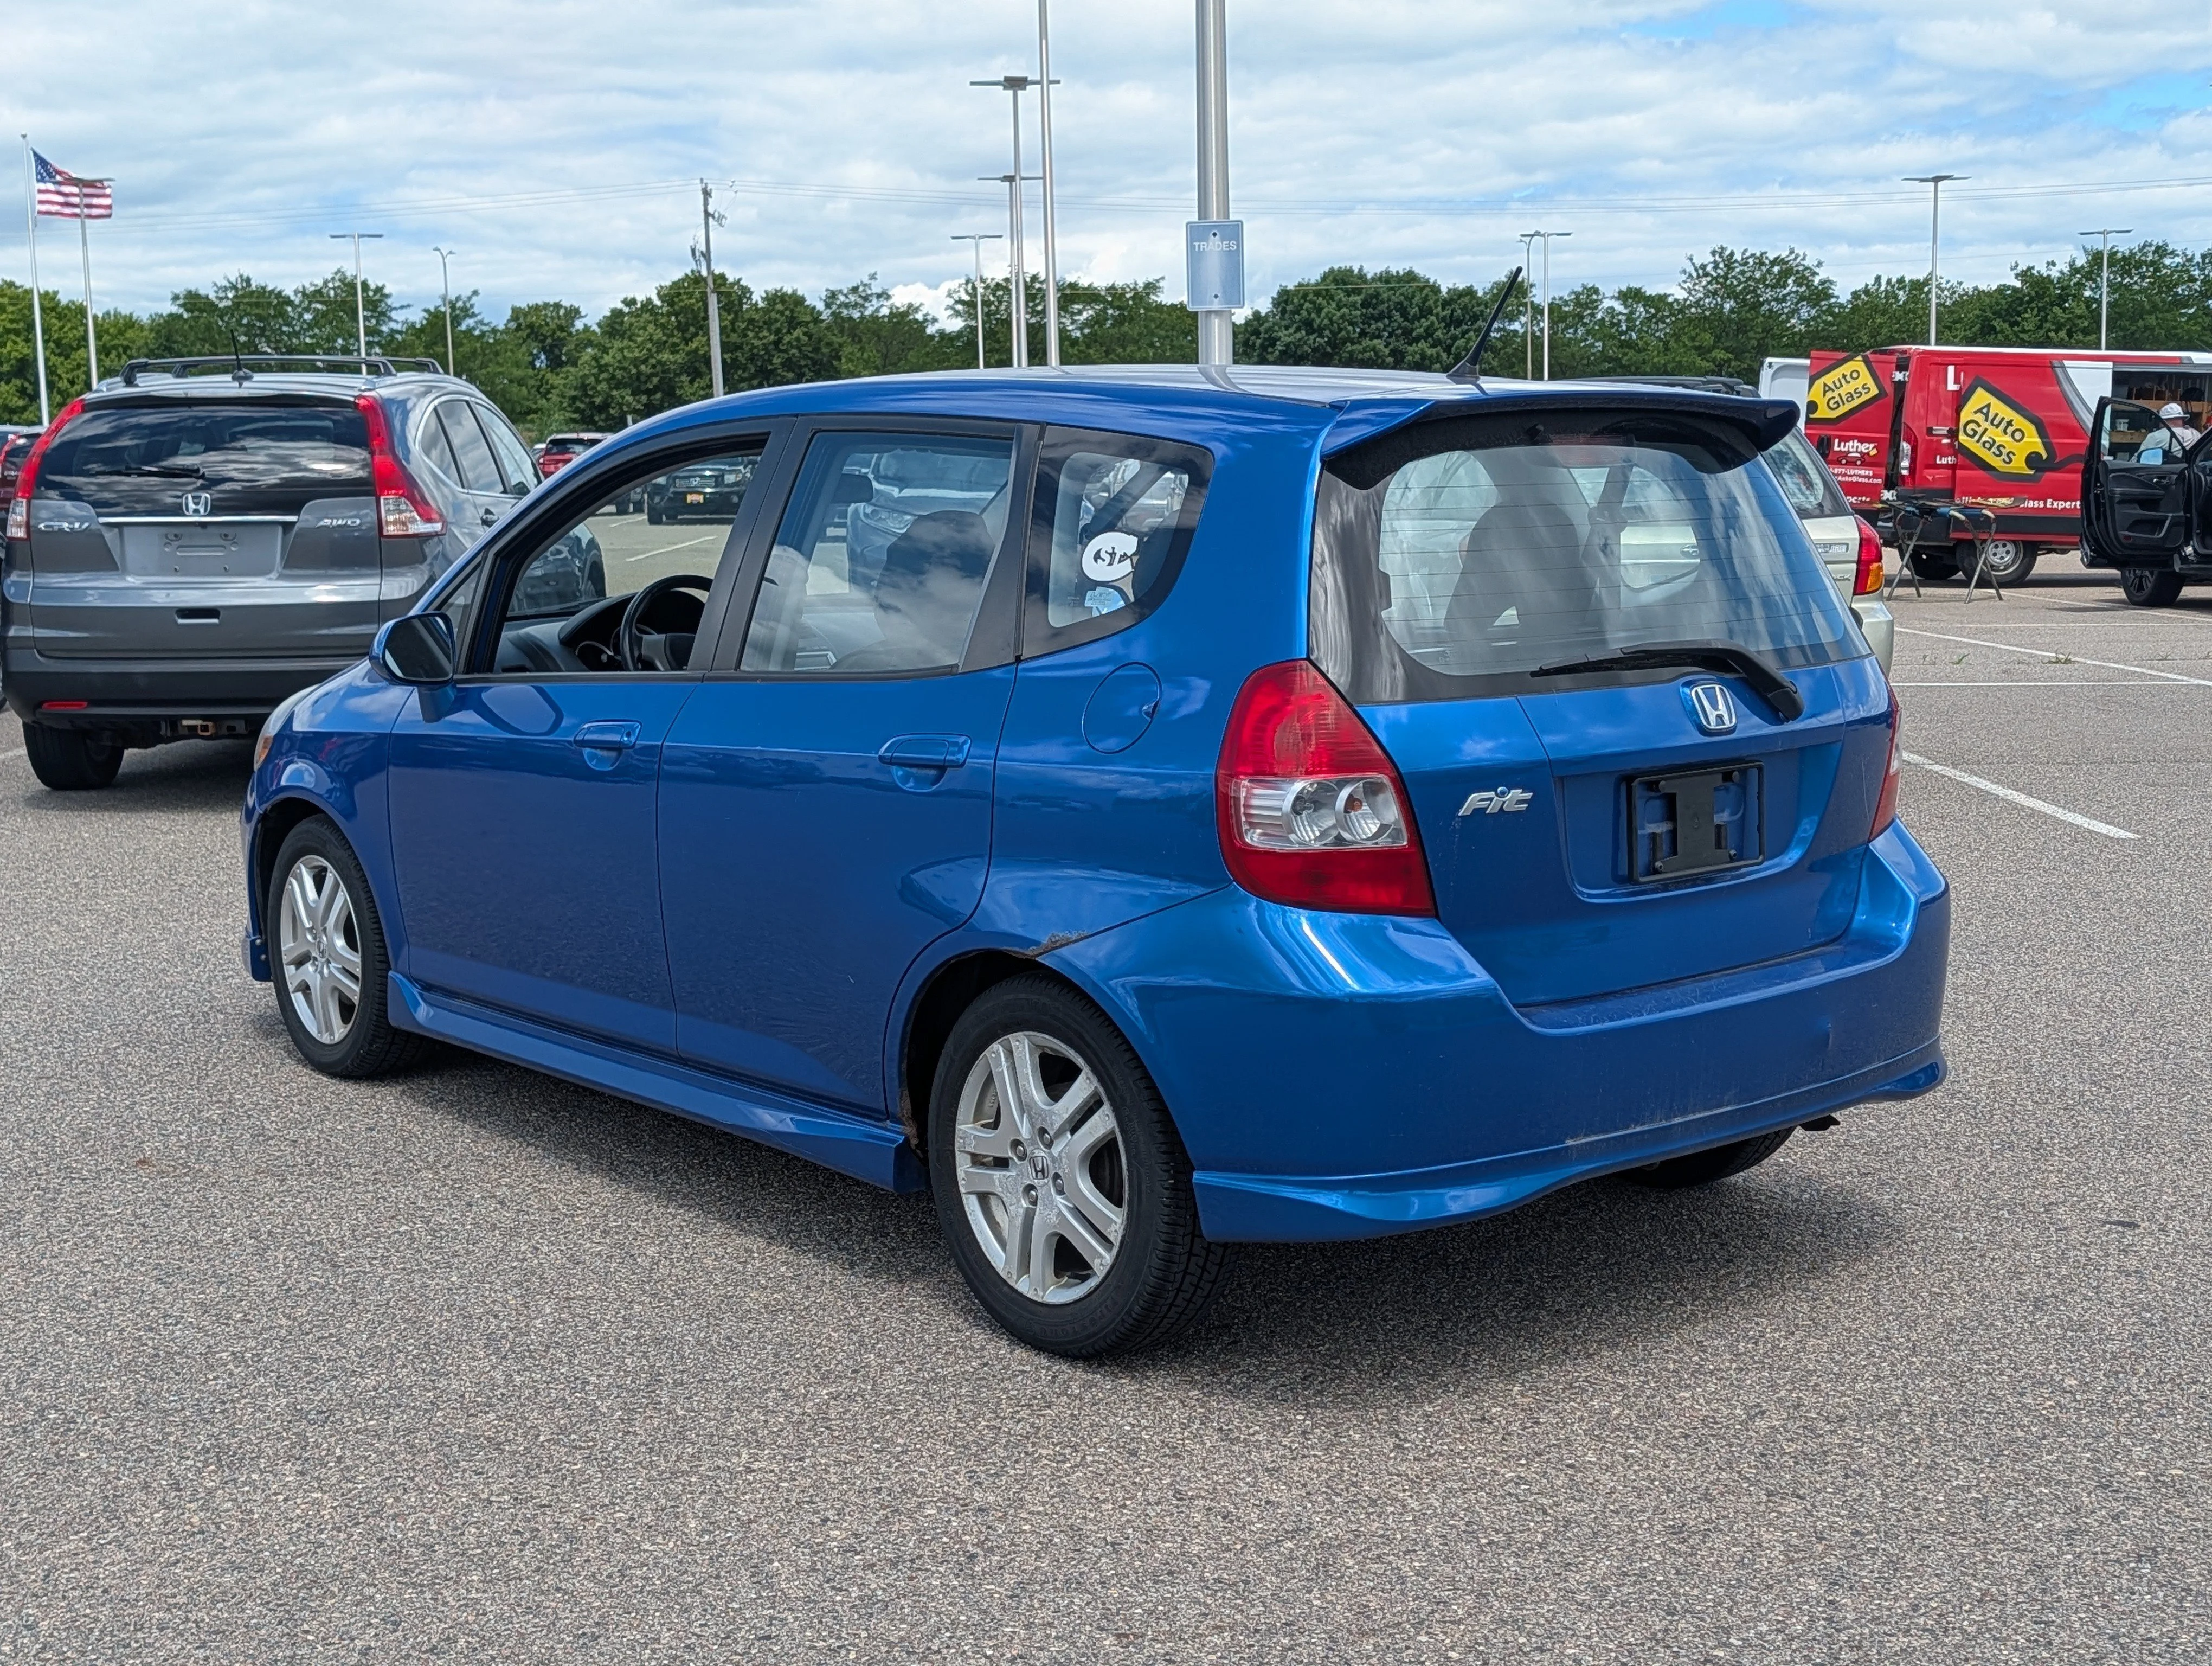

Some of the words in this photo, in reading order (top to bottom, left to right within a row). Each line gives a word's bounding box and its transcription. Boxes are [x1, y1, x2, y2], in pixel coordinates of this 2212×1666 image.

[1193, 241, 1237, 252] TRADES
[1823, 369, 1860, 398] Auto
[1826, 382, 1871, 411] Glass
[1973, 401, 2025, 443] Auto
[1833, 438, 1877, 453] Luther
[1963, 419, 2016, 465] Glass
[38, 521, 90, 532] CR-V
[315, 518, 361, 528] AWD
[1458, 786, 1534, 816] Fit
